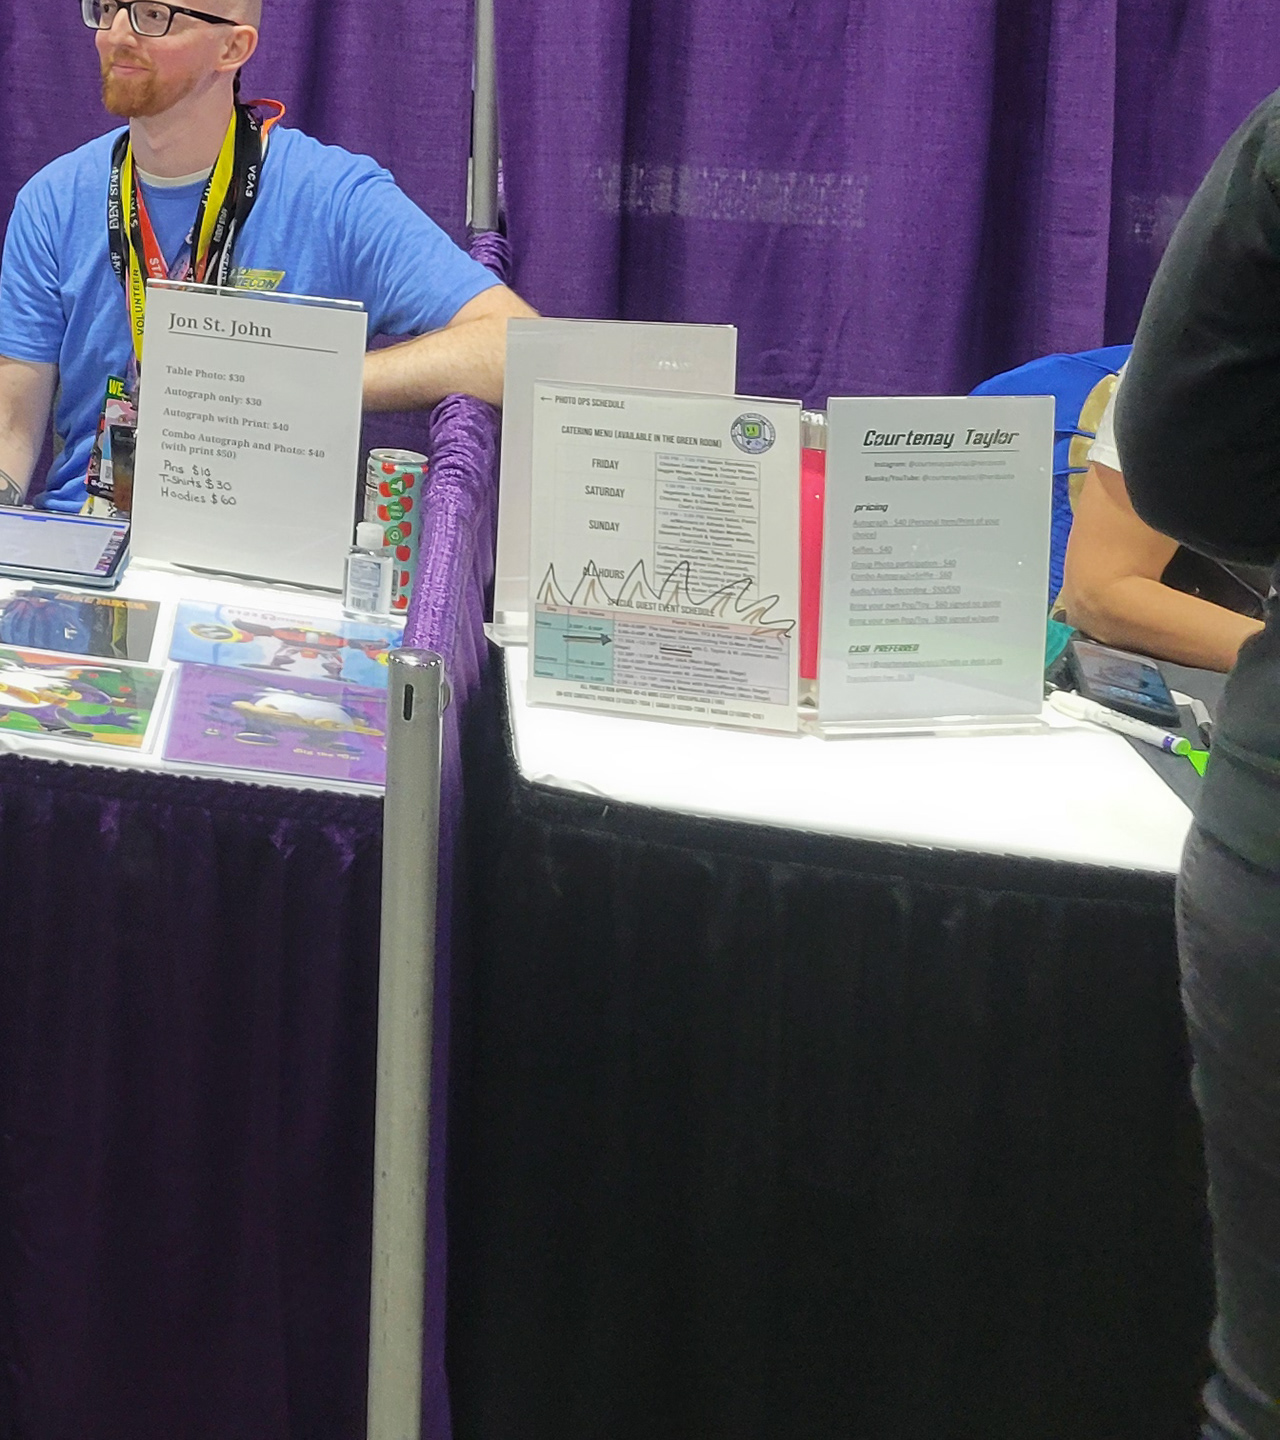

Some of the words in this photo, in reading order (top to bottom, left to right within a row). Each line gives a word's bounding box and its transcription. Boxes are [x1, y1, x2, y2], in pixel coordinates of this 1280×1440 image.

[108, 199, 120, 230] EVENT
[132, 269, 145, 335] VOLUNTEER
[168, 312, 198, 330] Jon
[203, 317, 225, 332] St.
[229, 319, 272, 338] John
[166, 365, 193, 377] Table
[195, 369, 226, 381] Photo:
[229, 373, 245, 383] $30
[164, 386, 216, 402] Autograph
[218, 393, 244, 405] only:
[245, 396, 262, 407] $30
[555, 395, 576, 405] PHOTO
[578, 397, 591, 406] OPS
[592, 398, 625, 409] SCHEDULE
[163, 408, 215, 423] Autograph
[217, 414, 239, 425] with
[242, 418, 270, 429] Print:
[272, 422, 289, 432] $40
[162, 428, 196, 440] Combo
[198, 433, 250, 449] Autograph
[252, 440, 271, 451] and
[274, 444, 305, 456] Photo:
[308, 448, 325, 458] $40
[561, 425, 592, 436] CATERING
[594, 428, 613, 438] MENU
[615, 430, 652, 442] (AVAILABLE
[654, 433, 660, 443] IN
[662, 434, 675, 444] THE
[676, 435, 698, 446] GREEN
[699, 438, 722, 448] ROOM)
[862, 429, 955, 449] Courtenay
[964, 428, 1020, 449] Taylor
[161, 441, 187, 453] (with
[189, 445, 214, 458] print
[216, 448, 237, 460] $50)
[192, 464, 211, 477] $10
[592, 458, 619, 470] FRIDAY
[161, 487, 205, 504] Hoodies
[585, 485, 625, 498] SATURDAY
[854, 503, 888, 513] pricing
[589, 520, 620, 532] SUNDAY
[599, 568, 625, 580] HOURS
[635, 601, 657, 611] GUEST
[658, 603, 680, 614] EVENT
[680, 605, 715, 618] SCHEDULE
[848, 645, 871, 653] CASH
[874, 644, 920, 653] PREFERRED
